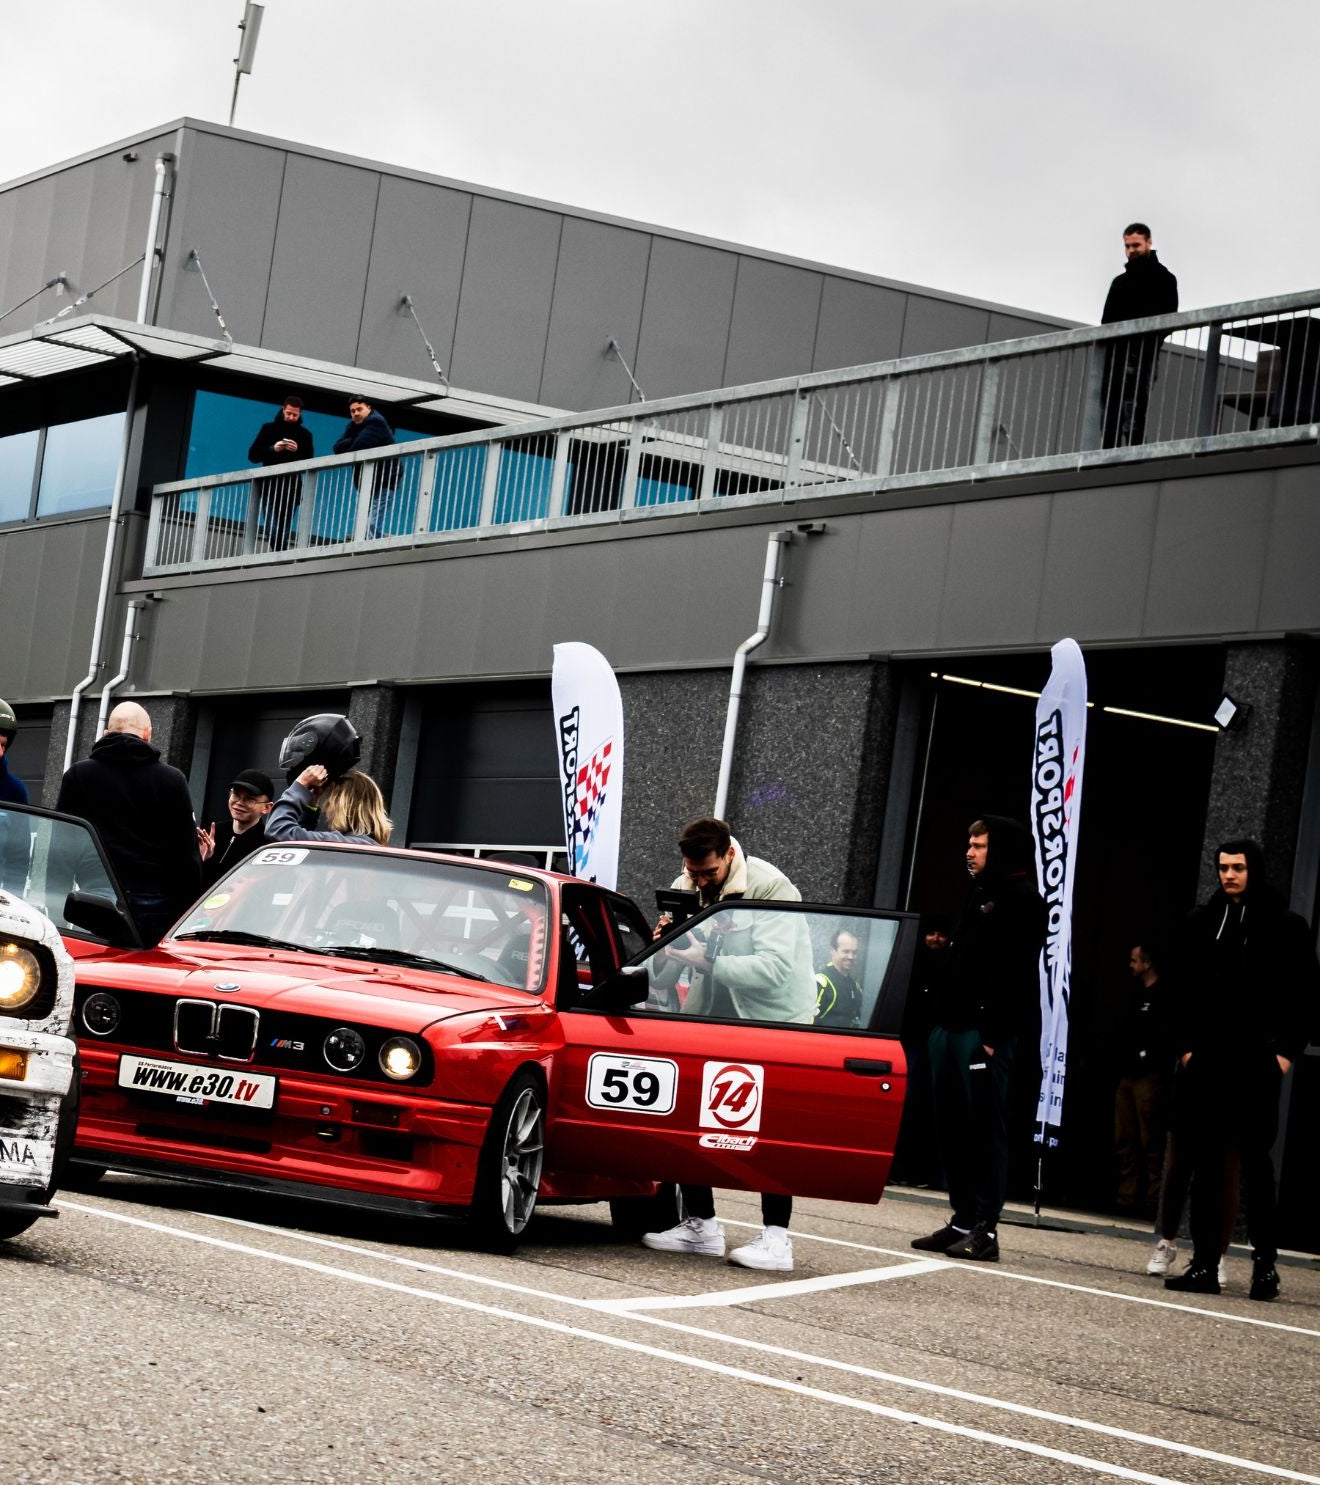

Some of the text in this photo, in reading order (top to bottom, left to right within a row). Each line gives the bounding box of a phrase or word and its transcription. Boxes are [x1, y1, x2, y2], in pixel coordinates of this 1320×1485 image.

[261, 852, 296, 863] 59
[133, 1066, 261, 1102] www.e30.tv
[600, 1068, 660, 1106] 59
[708, 1080, 756, 1113] 14
